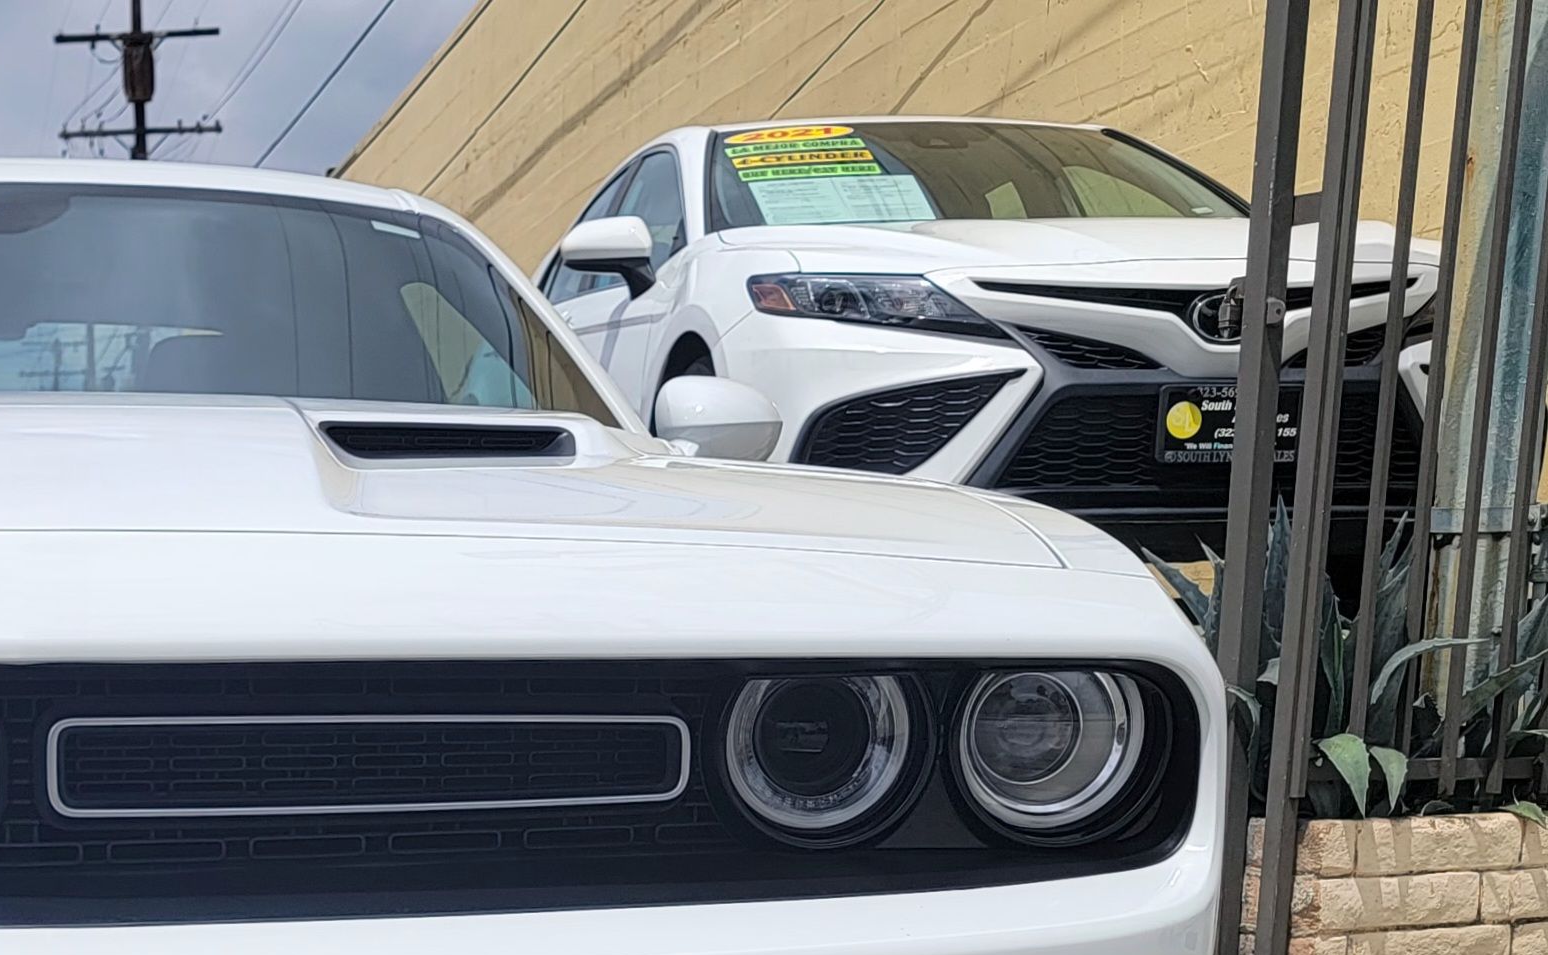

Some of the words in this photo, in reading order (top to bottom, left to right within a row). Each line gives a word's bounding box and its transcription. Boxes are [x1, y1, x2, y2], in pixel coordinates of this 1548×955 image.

[742, 126, 835, 141] 2021
[753, 142, 800, 152] MEJOR
[802, 139, 860, 148] COMPRA
[737, 151, 869, 165] 4-CYLINDER
[1201, 400, 1233, 411] South
